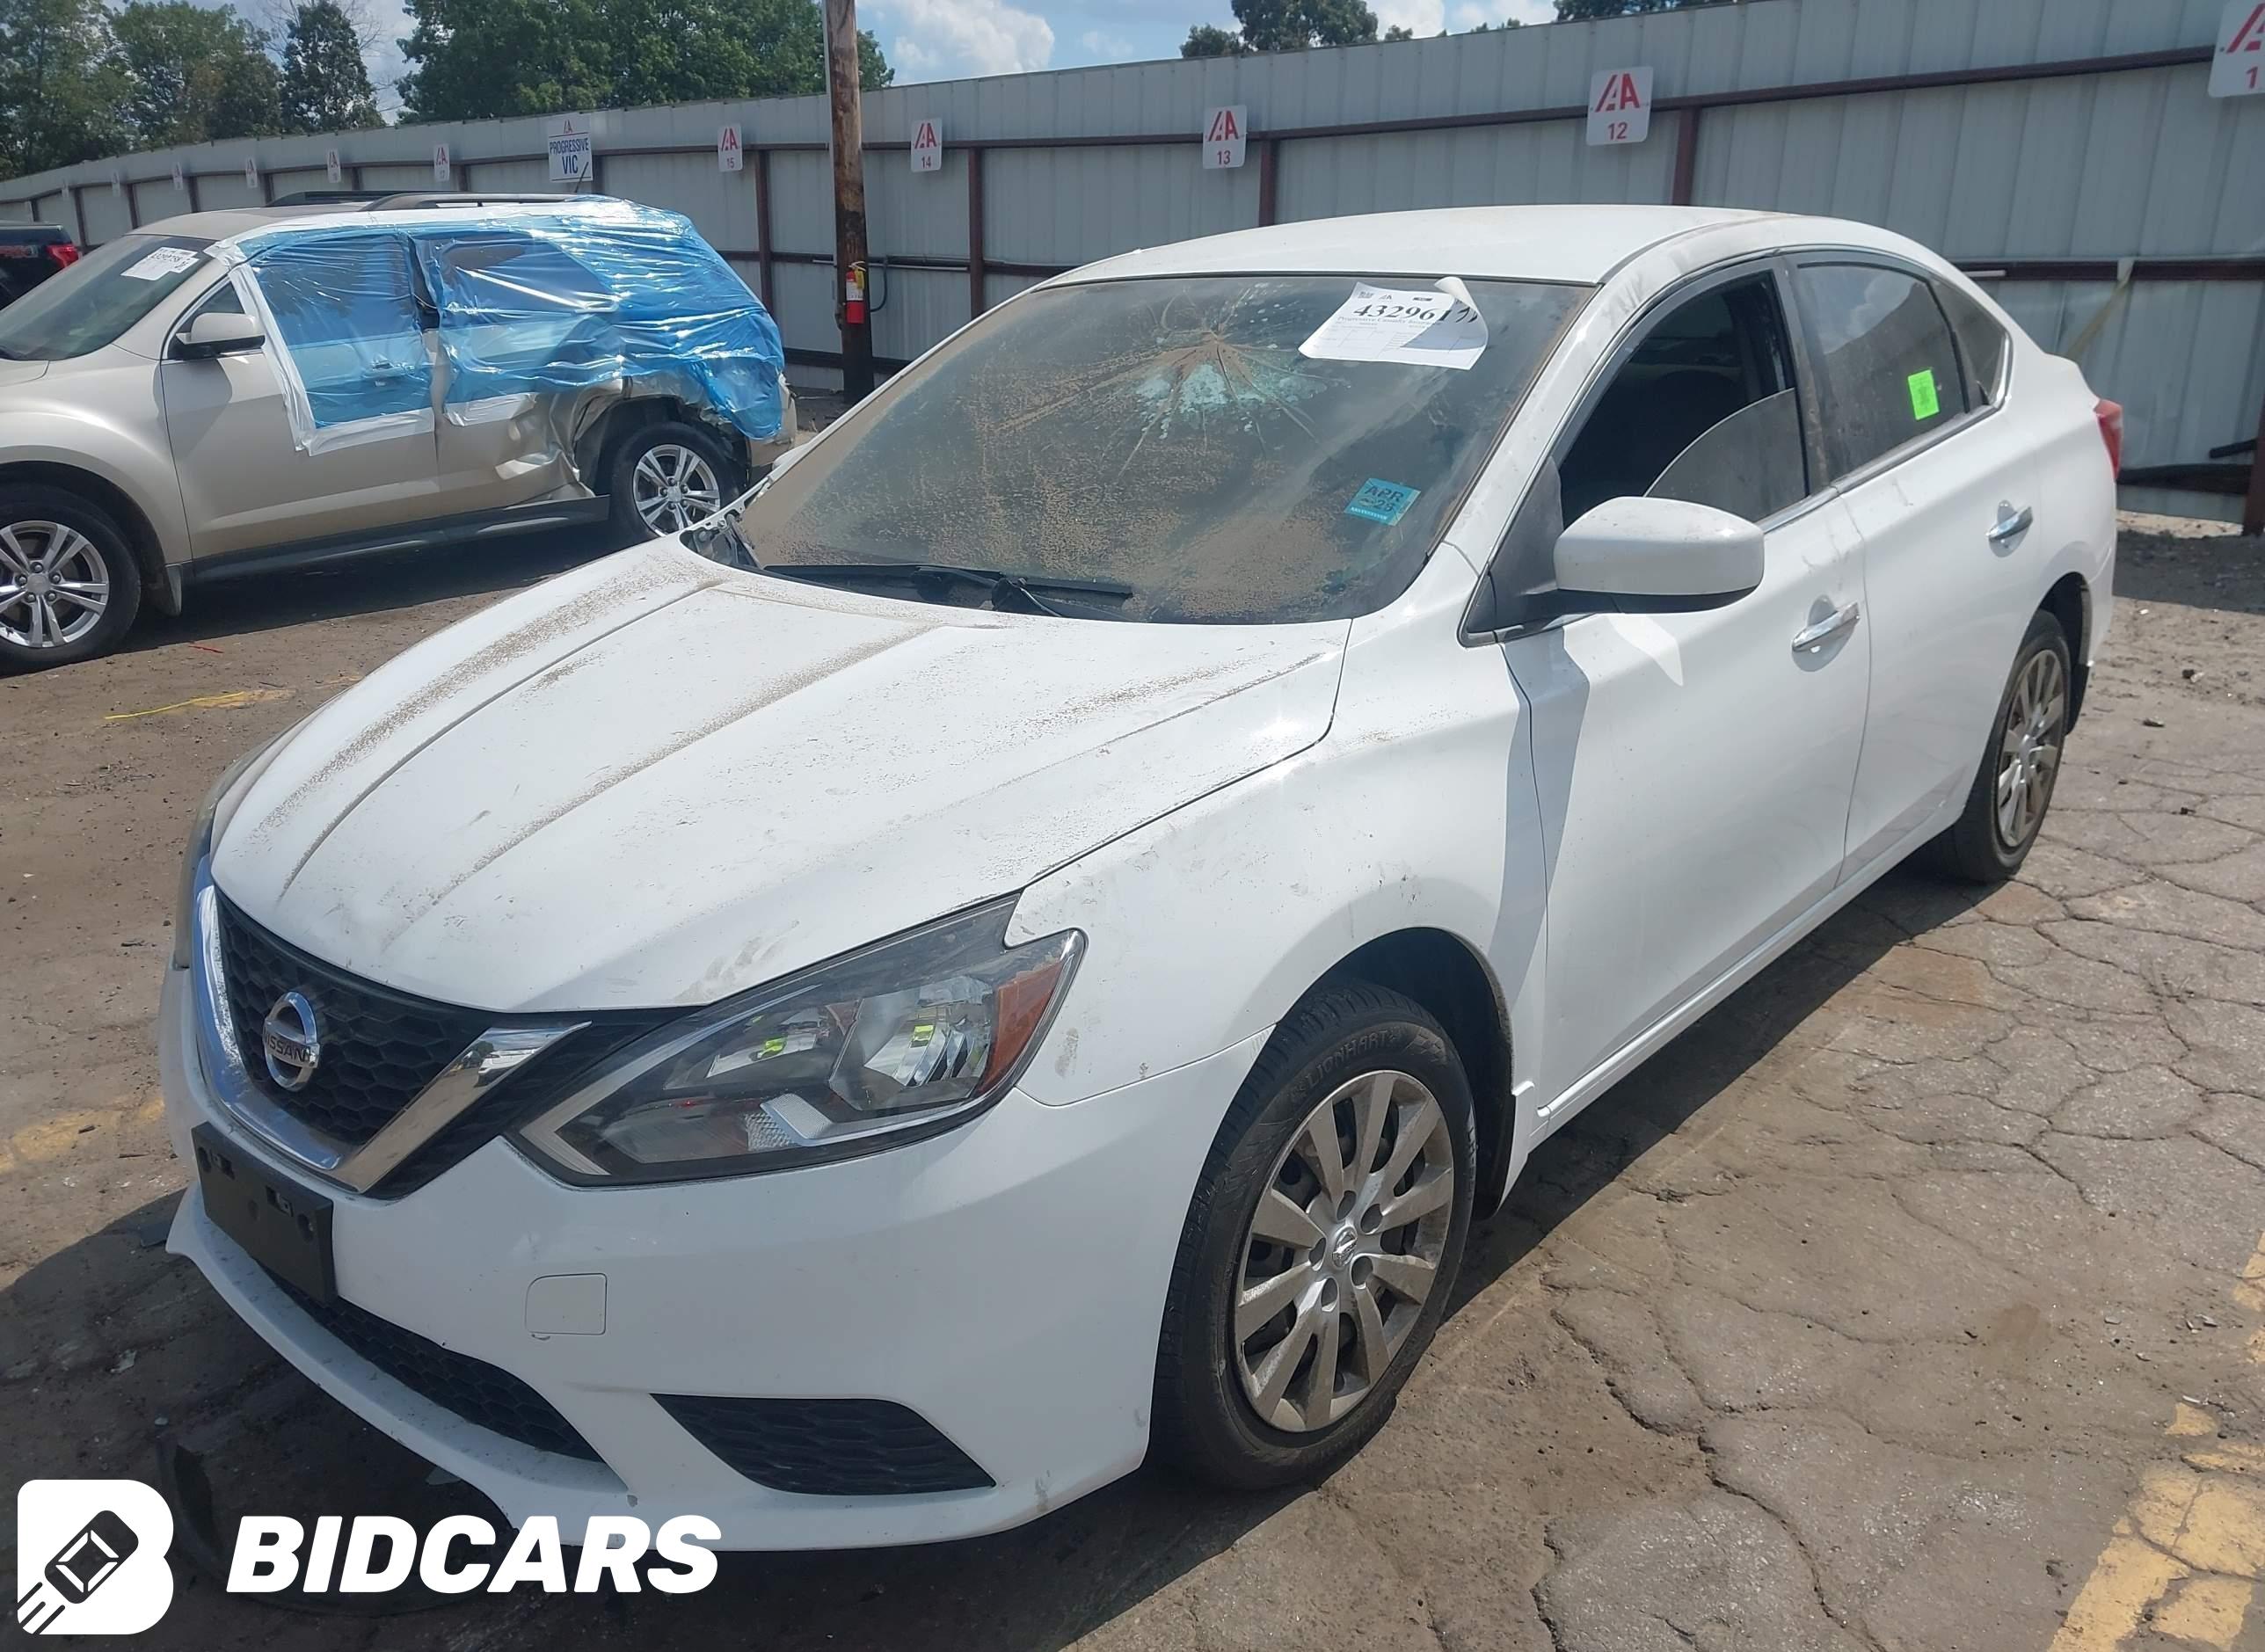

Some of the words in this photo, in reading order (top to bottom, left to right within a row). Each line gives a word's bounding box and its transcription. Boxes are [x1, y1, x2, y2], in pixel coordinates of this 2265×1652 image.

[1607, 121, 1628, 140] 12
[550, 138, 588, 154] PROGRESSIVE
[562, 155, 578, 174] VIC
[727, 157, 734, 169] 15
[921, 156, 931, 168] 14
[1217, 150, 1231, 164] 13
[1365, 486, 1403, 502] APR
